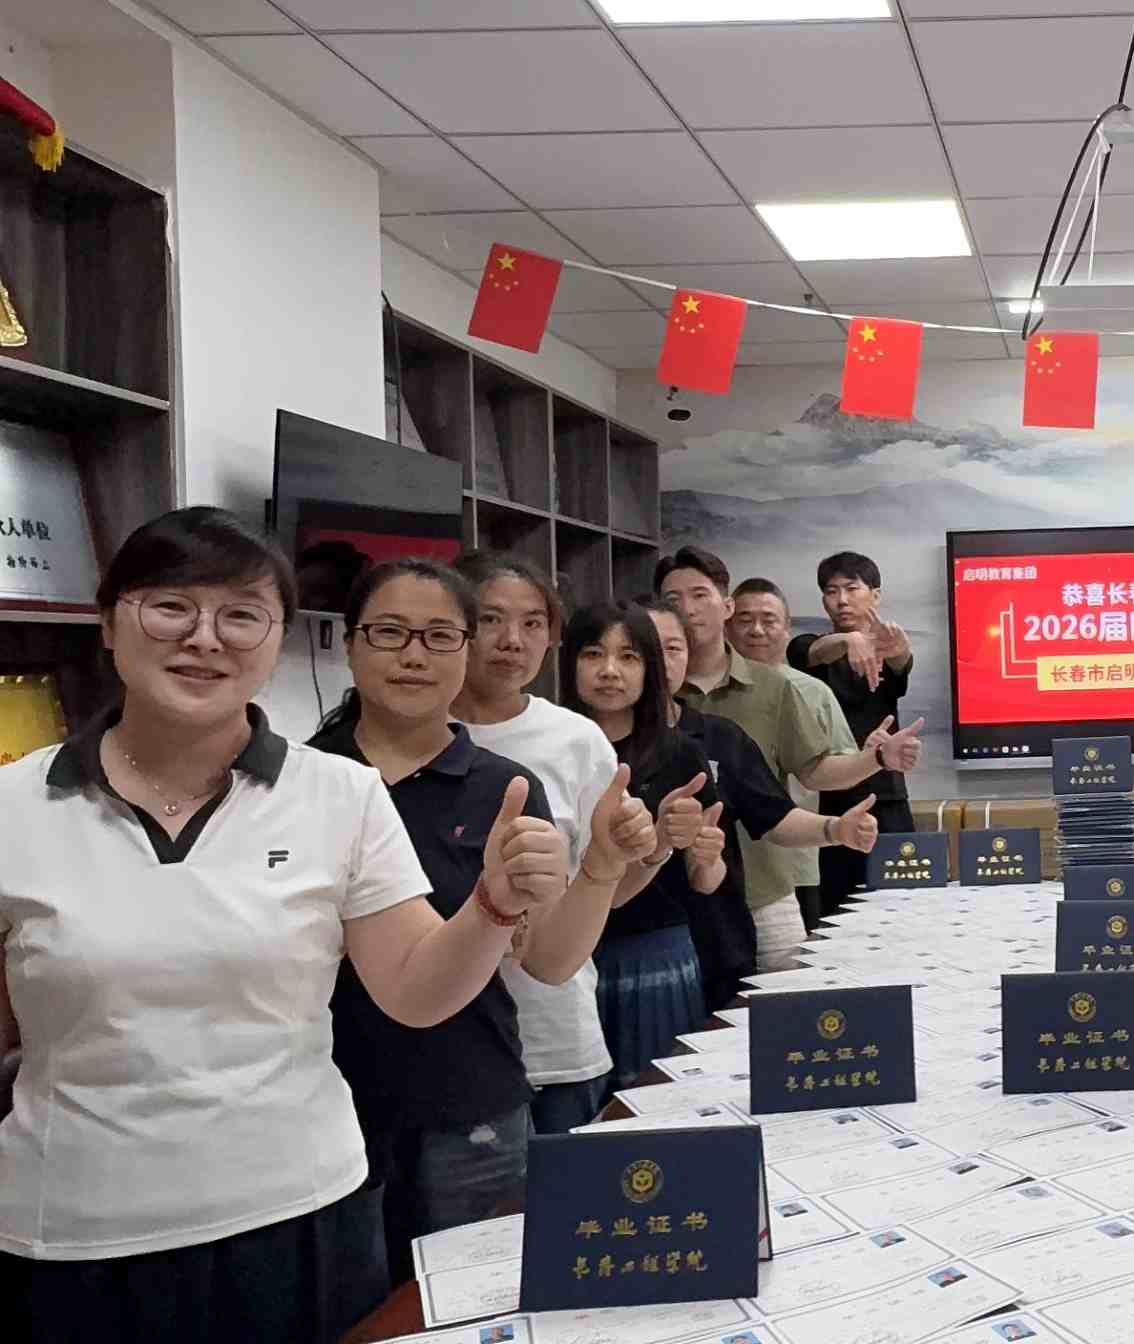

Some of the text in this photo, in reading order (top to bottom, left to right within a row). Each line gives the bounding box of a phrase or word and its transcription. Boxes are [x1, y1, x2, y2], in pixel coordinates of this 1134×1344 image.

[962, 565, 1038, 581] 启明教育集团
[1038, 1028, 1130, 1046] 毕业证书
[575, 1211, 709, 1239] 毕业证书
